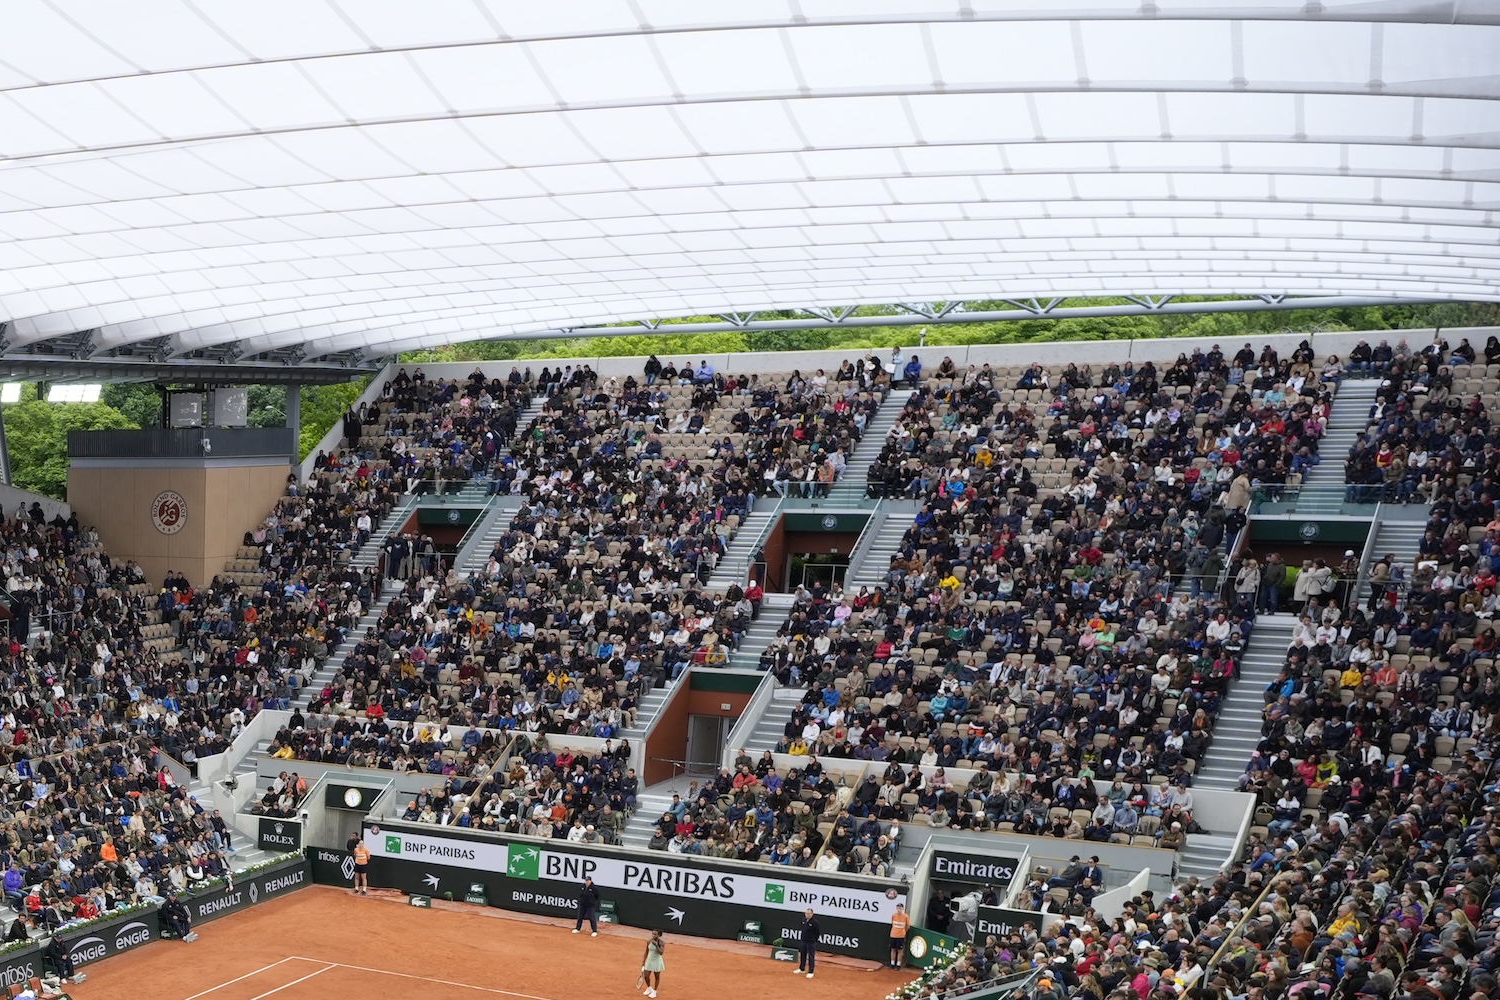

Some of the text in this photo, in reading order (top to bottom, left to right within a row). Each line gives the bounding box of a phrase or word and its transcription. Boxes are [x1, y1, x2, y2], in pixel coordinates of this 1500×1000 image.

[262, 833, 295, 846] ROLEX
[318, 850, 340, 863] Infosys
[404, 842, 475, 860] BNP PARIBAS
[546, 856, 735, 898] BNP PARIBAS
[935, 856, 1012, 880] Emirates
[264, 870, 305, 894] RENAULT
[199, 892, 242, 917] RENAULT
[512, 890, 578, 909] BNP PARIBAS
[789, 890, 879, 912] BNP PARIBAS
[740, 935, 760, 943] LACOSTE
[818, 934, 859, 948] ARIBAS
